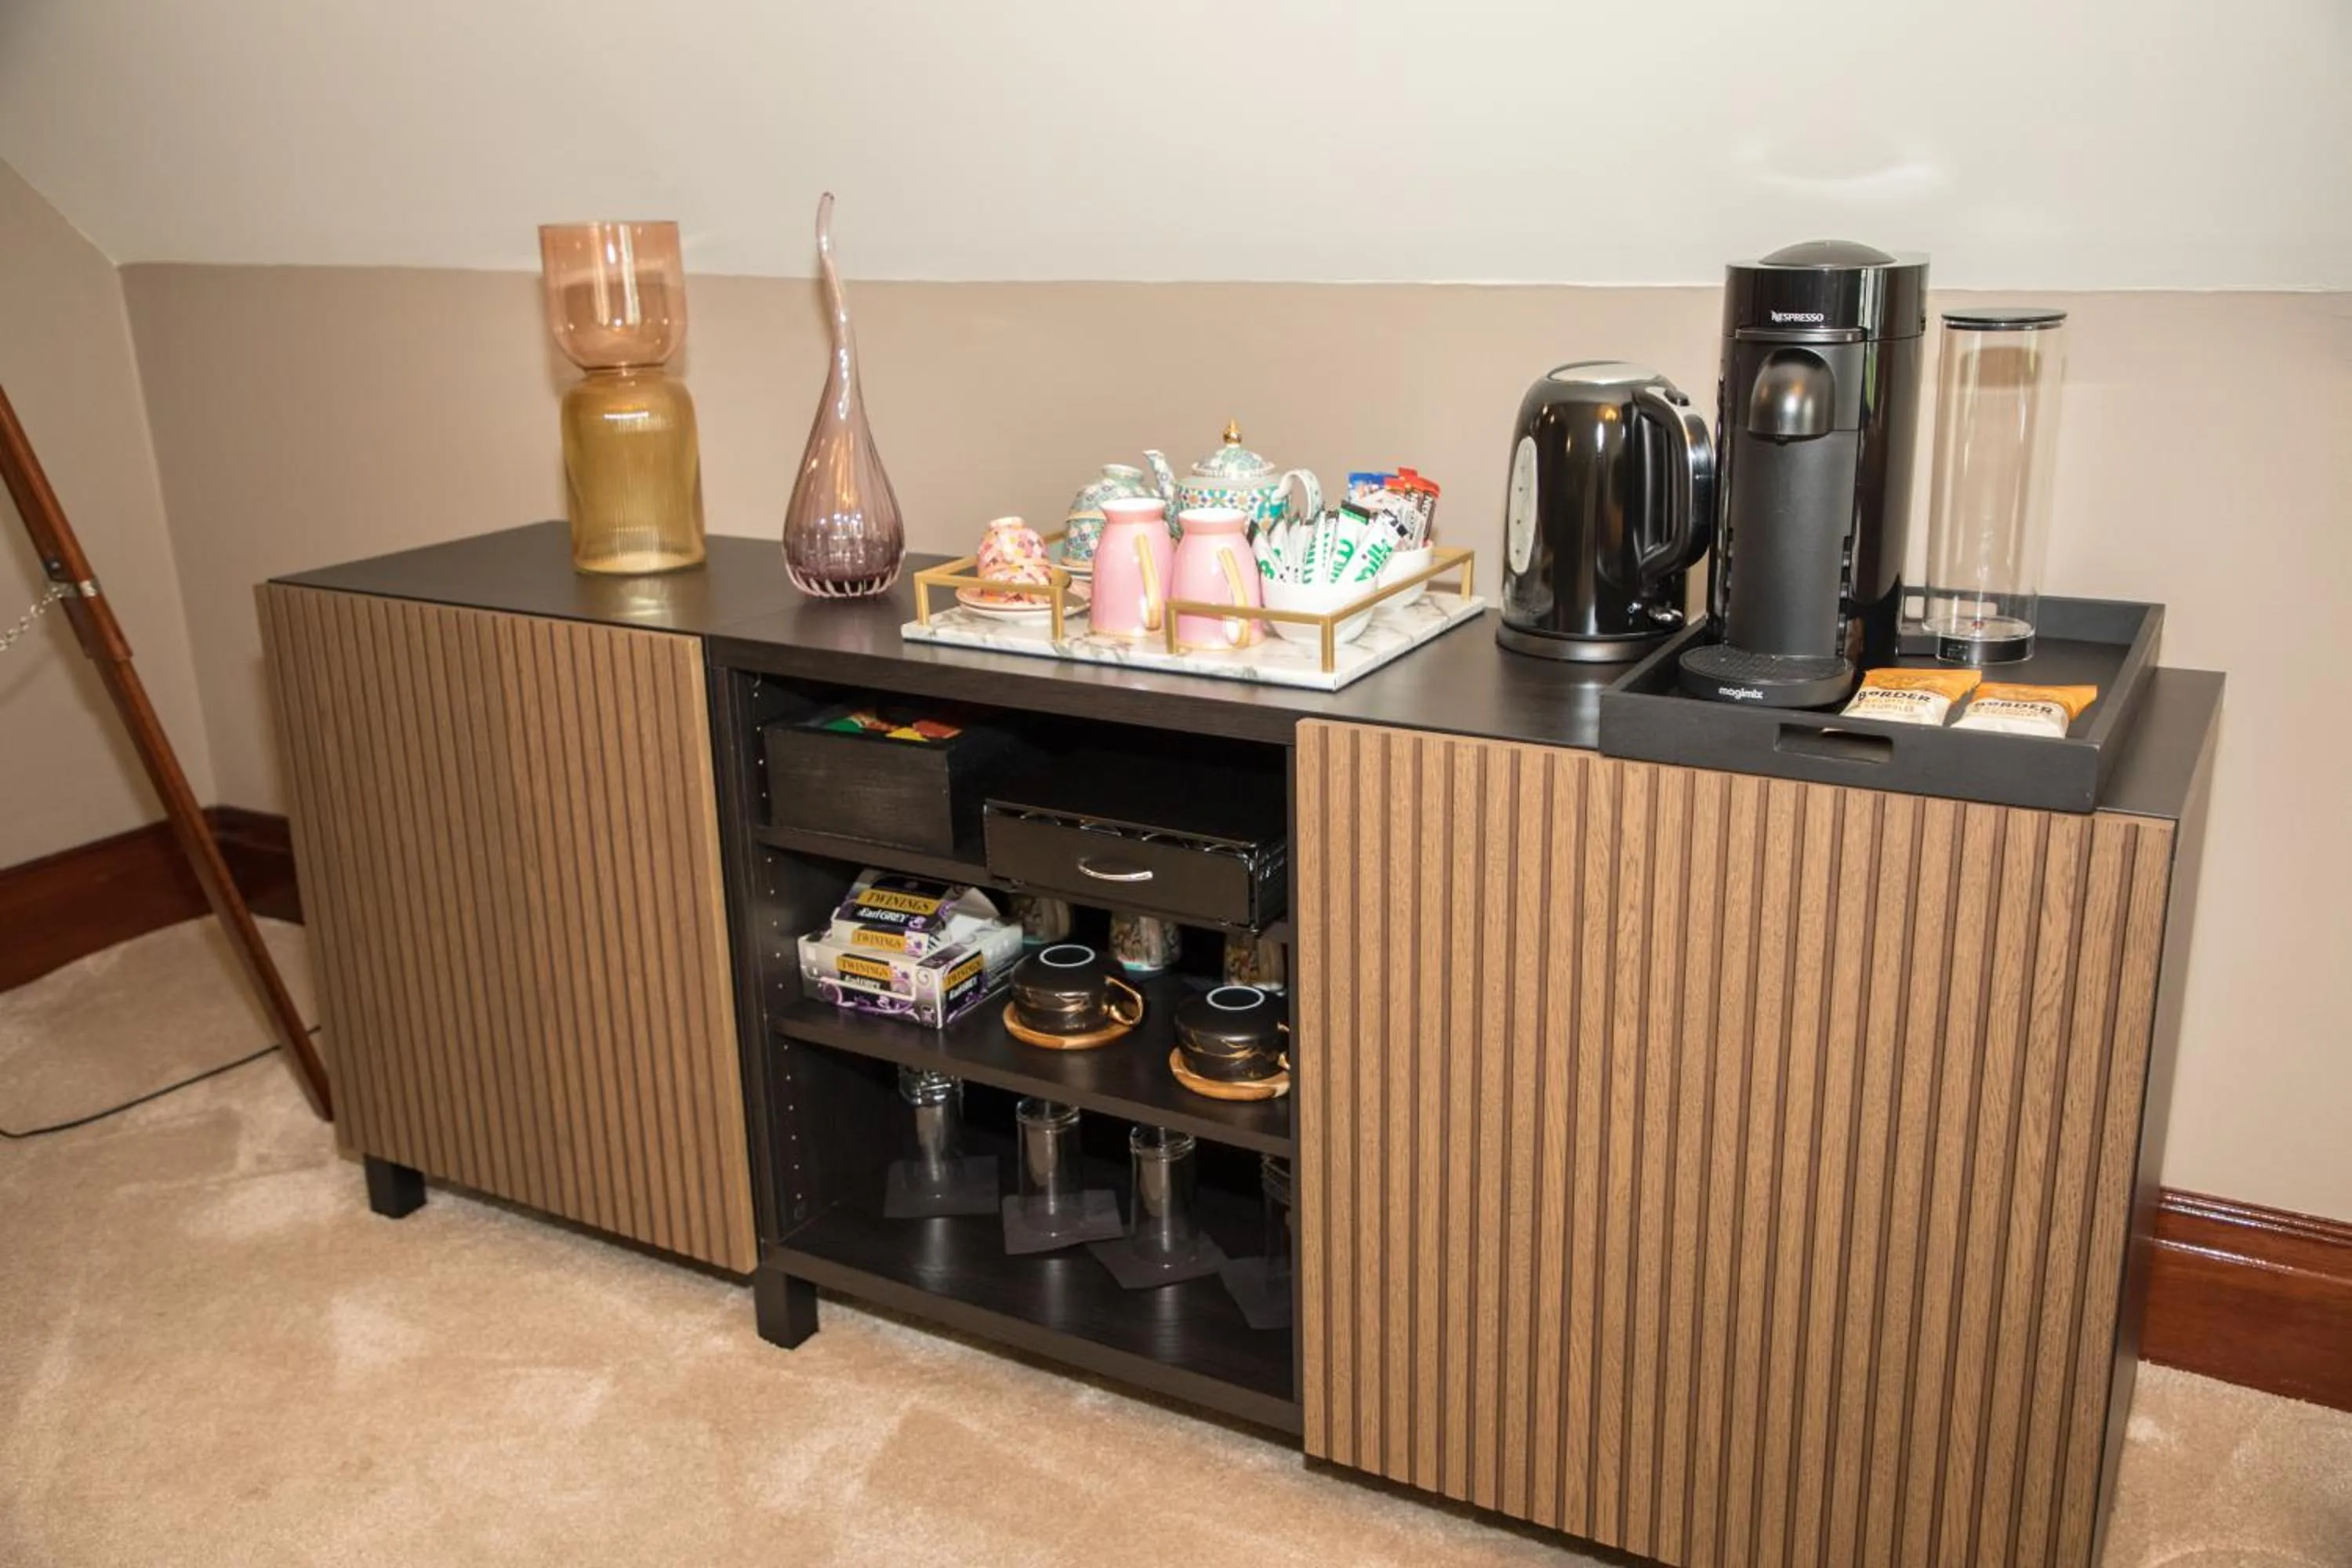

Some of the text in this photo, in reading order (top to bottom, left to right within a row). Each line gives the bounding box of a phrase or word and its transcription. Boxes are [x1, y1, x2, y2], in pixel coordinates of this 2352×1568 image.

[1771, 310, 1824, 322] NESPRESSO
[1719, 687, 1763, 699] magimix
[1857, 691, 1931, 702] BORDER
[866, 891, 930, 911] TWININGS
[856, 933, 902, 949] TWININGS
[843, 960, 889, 978] TWININGS
